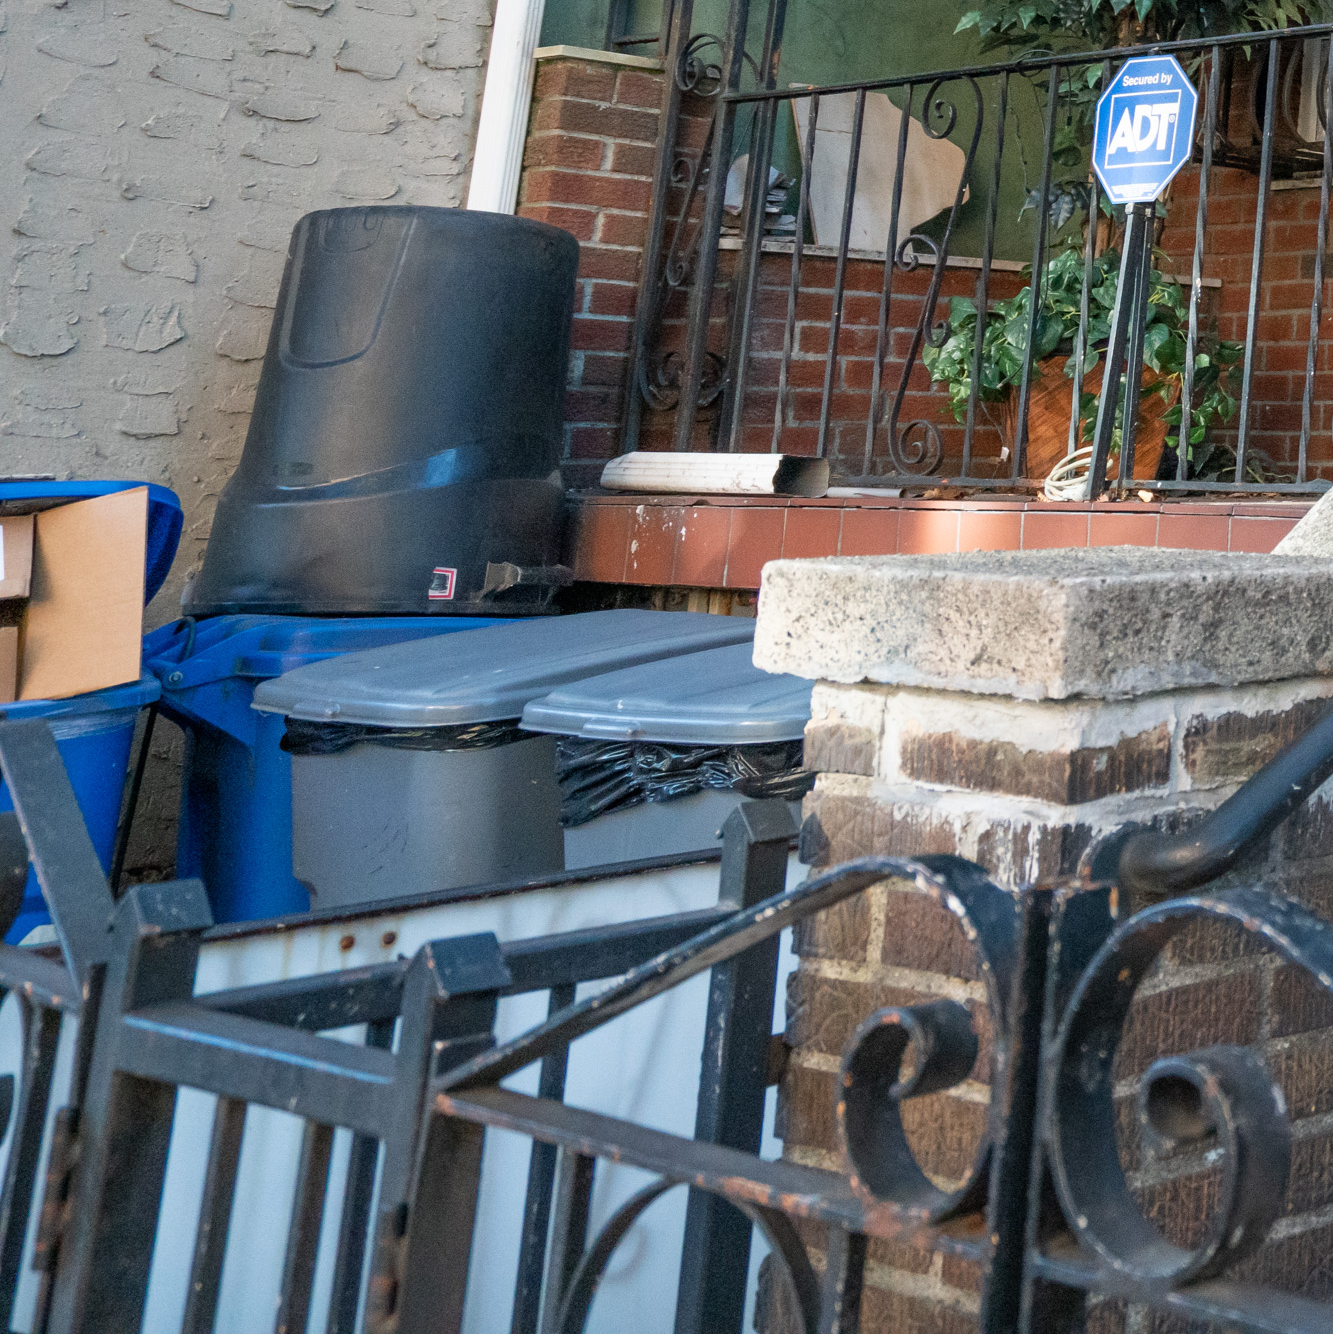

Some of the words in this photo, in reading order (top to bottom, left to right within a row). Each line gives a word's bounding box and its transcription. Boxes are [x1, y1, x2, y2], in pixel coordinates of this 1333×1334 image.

[1122, 73, 1159, 87] Secured
[1160, 72, 1173, 86] by
[1108, 102, 1179, 155] ADT
